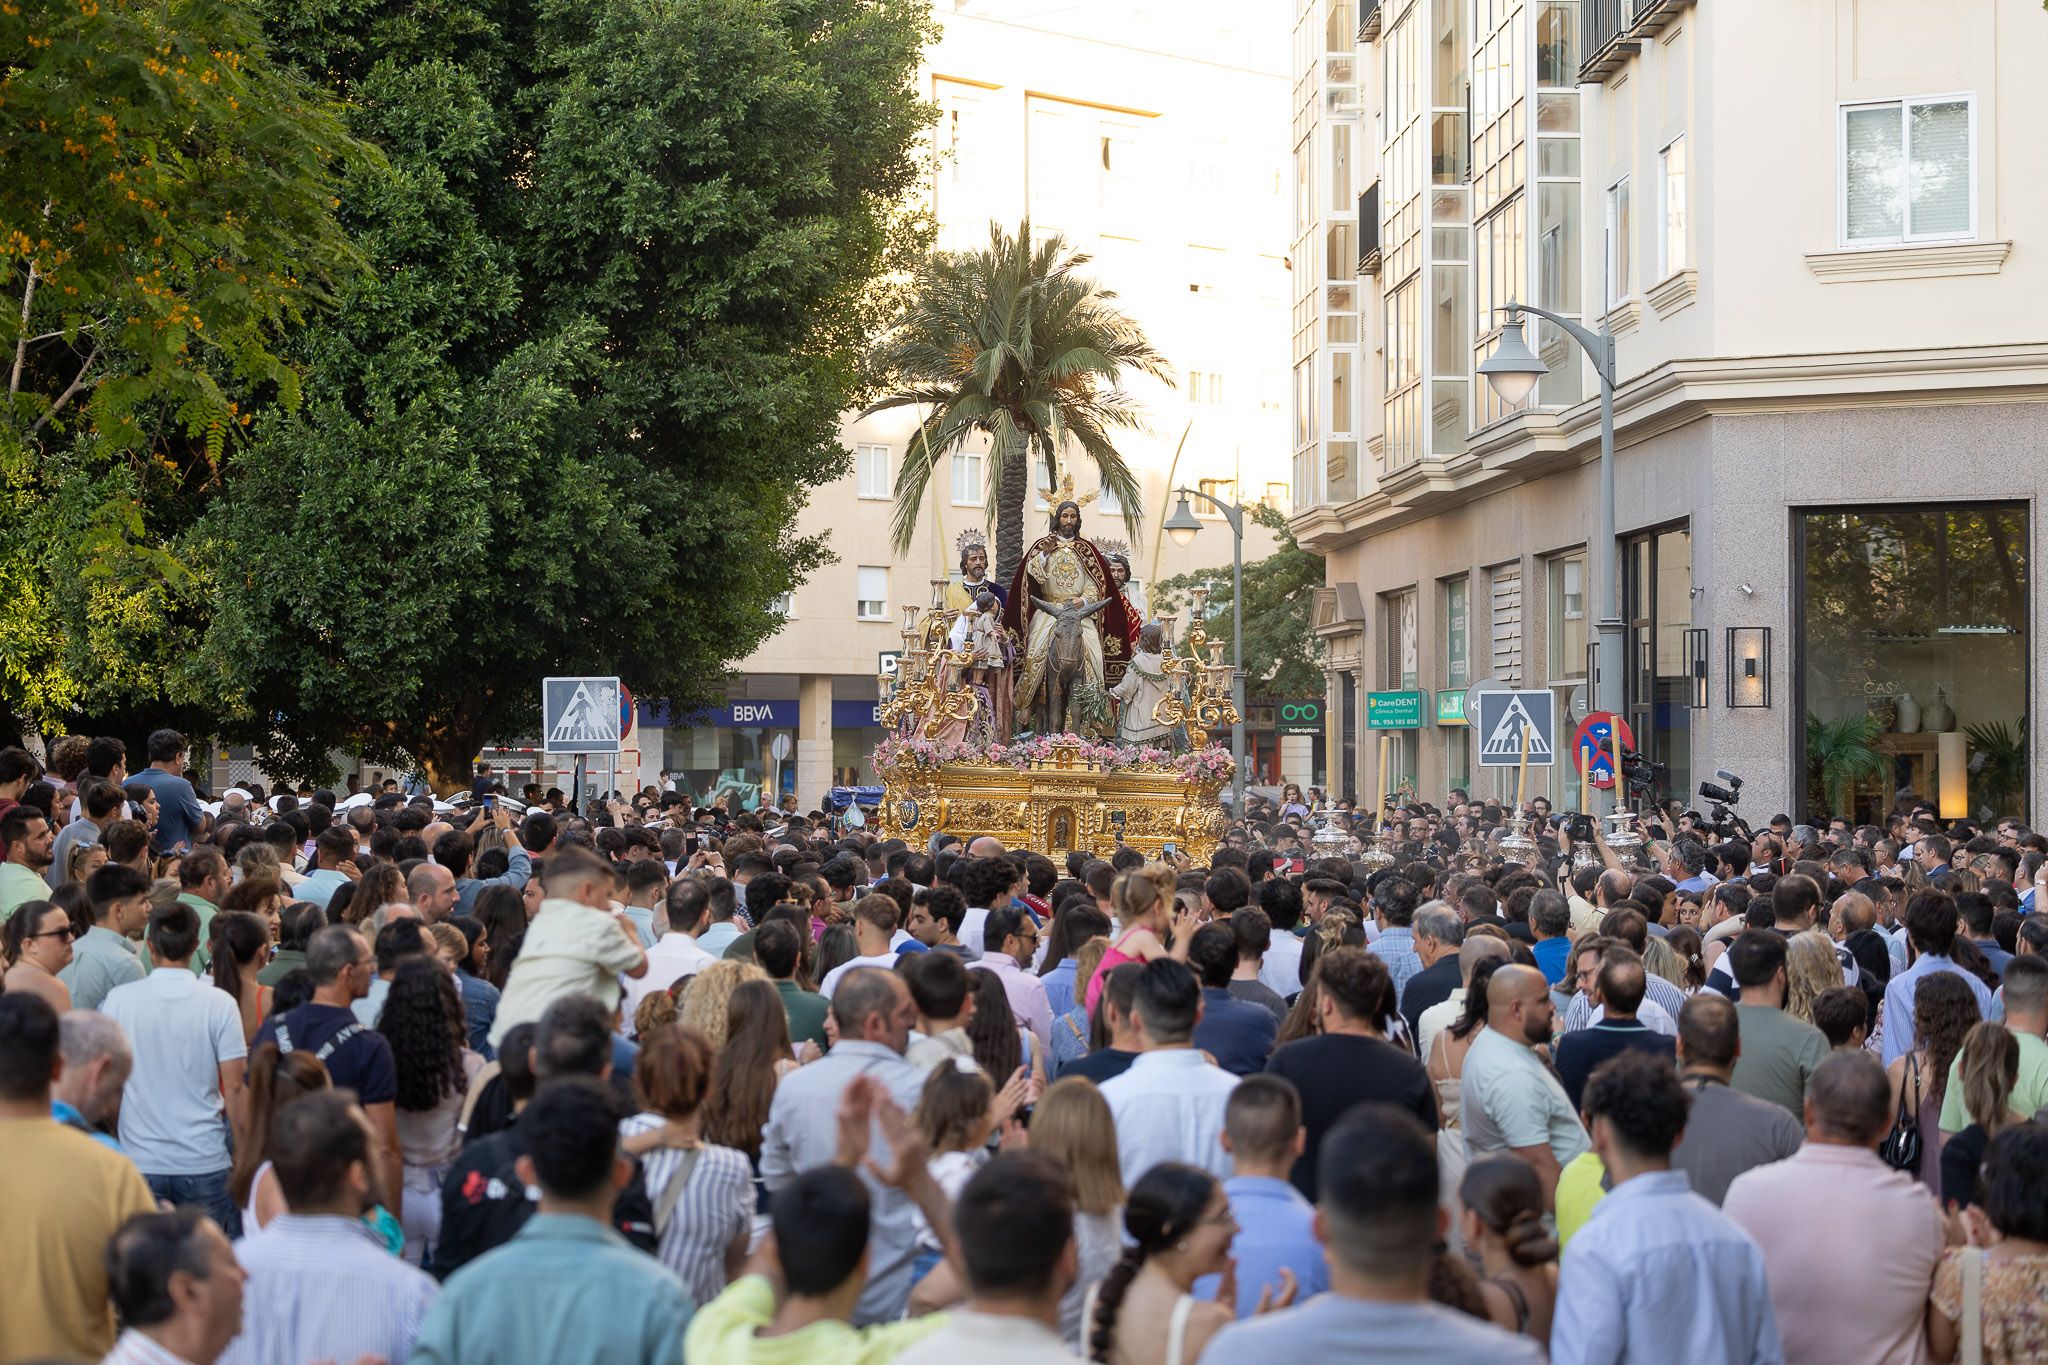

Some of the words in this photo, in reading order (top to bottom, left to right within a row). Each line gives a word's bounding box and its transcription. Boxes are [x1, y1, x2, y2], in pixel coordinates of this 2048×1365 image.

[1378, 698, 1417, 707] CareDENT
[733, 704, 773, 722] BBVA
[669, 772, 685, 780] BBVA
